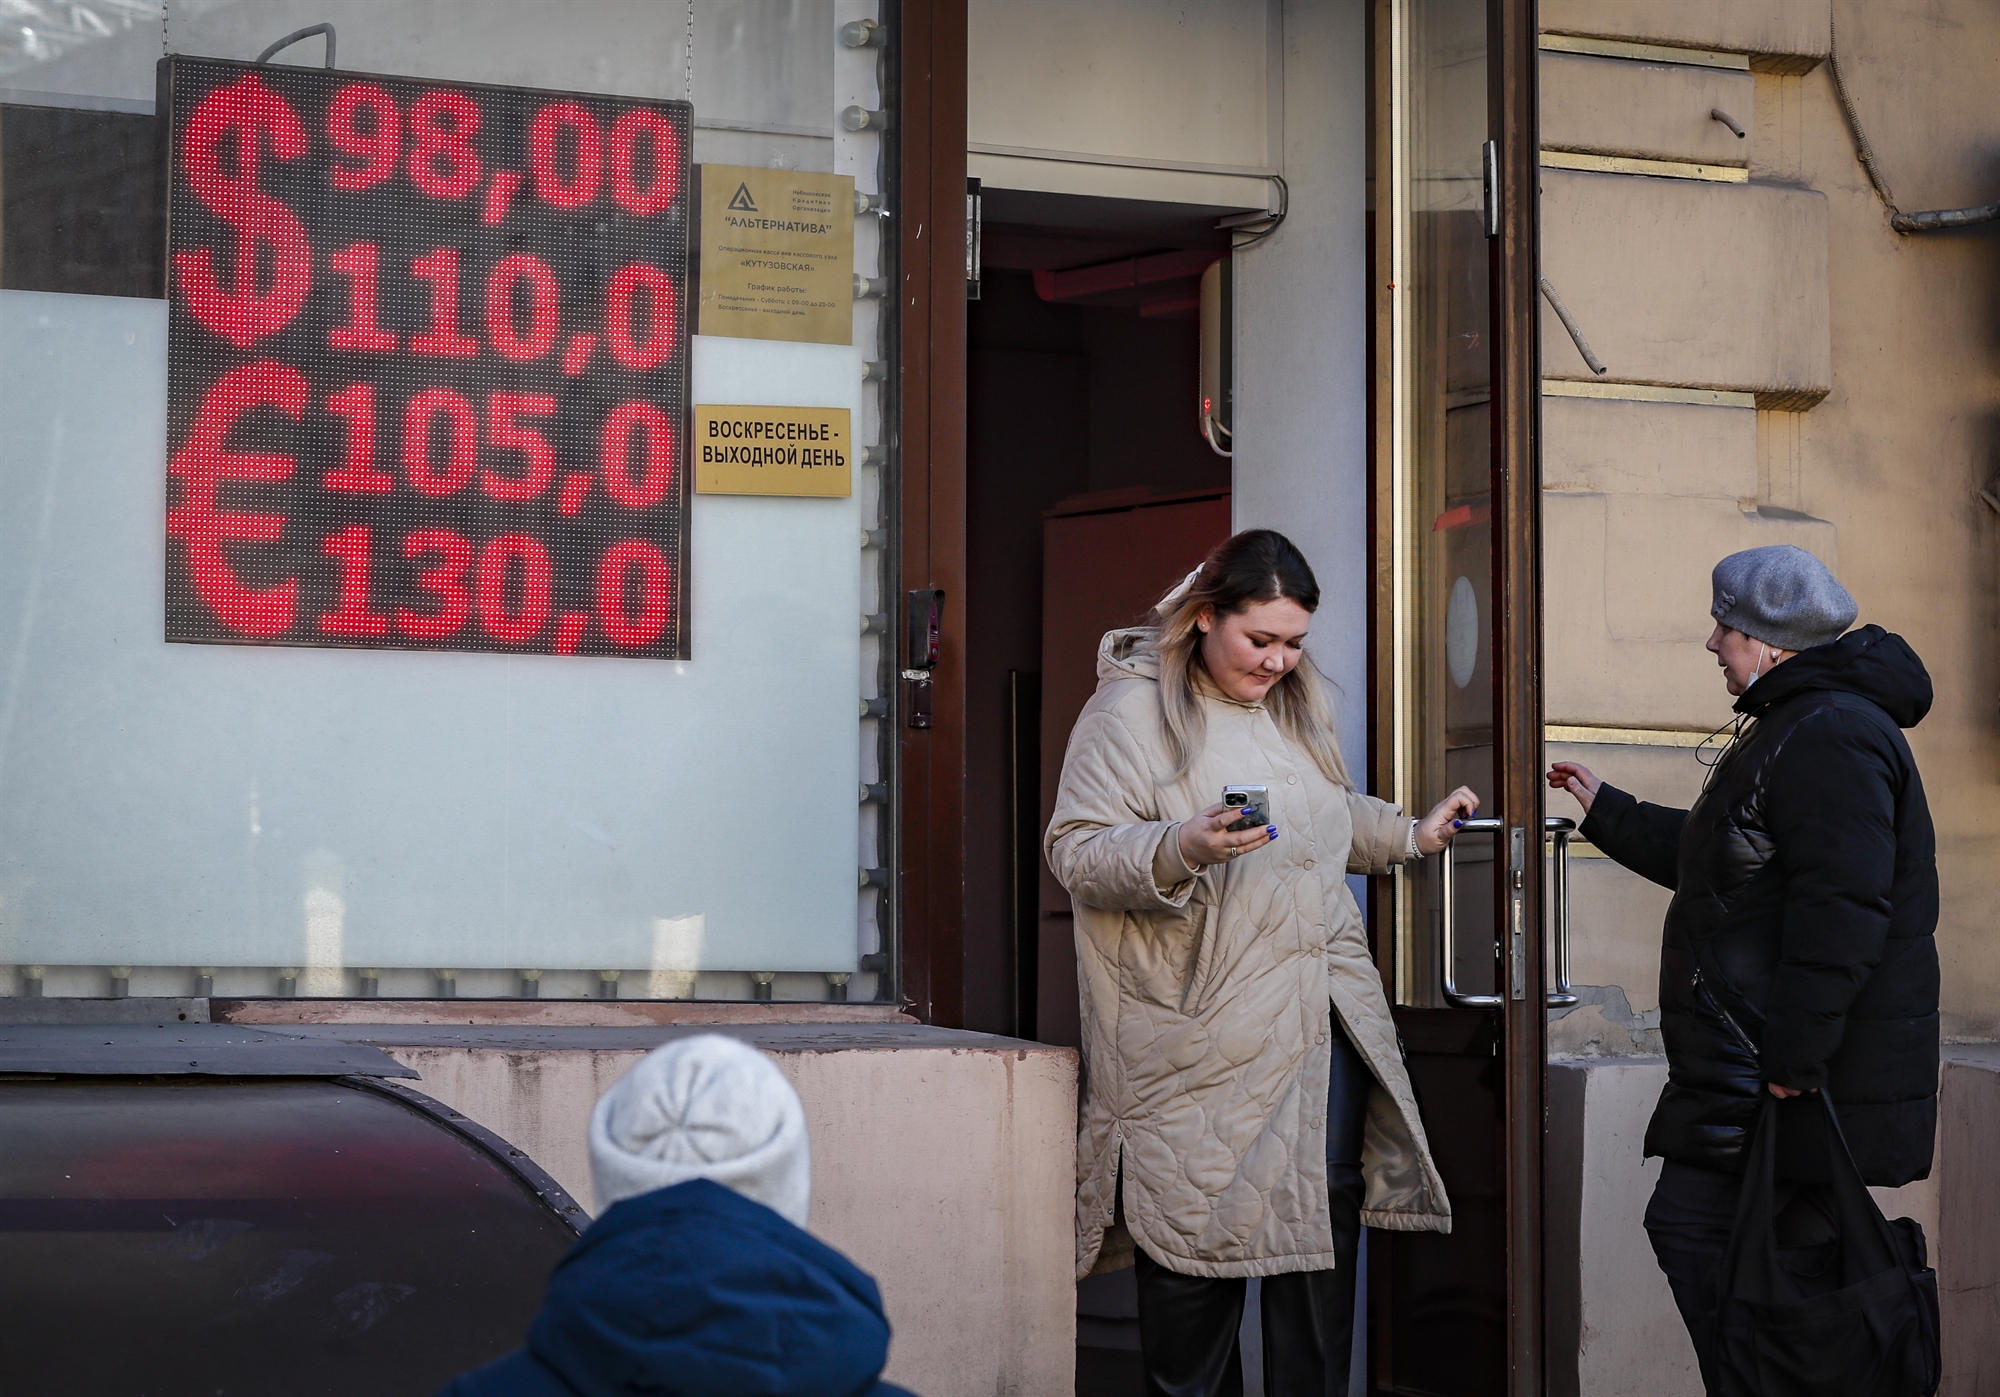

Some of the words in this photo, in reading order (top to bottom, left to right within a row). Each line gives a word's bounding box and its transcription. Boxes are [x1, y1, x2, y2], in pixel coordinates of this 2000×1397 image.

[327, 83, 680, 226] 98,00
[792, 190, 831, 198] Небанковская
[175, 72, 311, 347] $
[792, 205, 830, 213] Организация
[718, 245, 762, 254] Операционная
[740, 260, 815, 272] «КУТУЗОВСКАЯ»
[718, 294, 756, 302] Понедельник
[747, 283, 775, 292] График
[777, 286, 807, 294] работы:
[330, 241, 677, 377] 110,0
[762, 307, 791, 315] выходной
[709, 420, 829, 441] ВОСКРЕСЕНЬЕ
[323, 382, 674, 516] 105,0
[703, 443, 797, 467] ВЫХОДНОЙ
[801, 448, 845, 469] ДЕНЬ
[167, 358, 310, 637] €
[318, 525, 670, 655] 130,0
